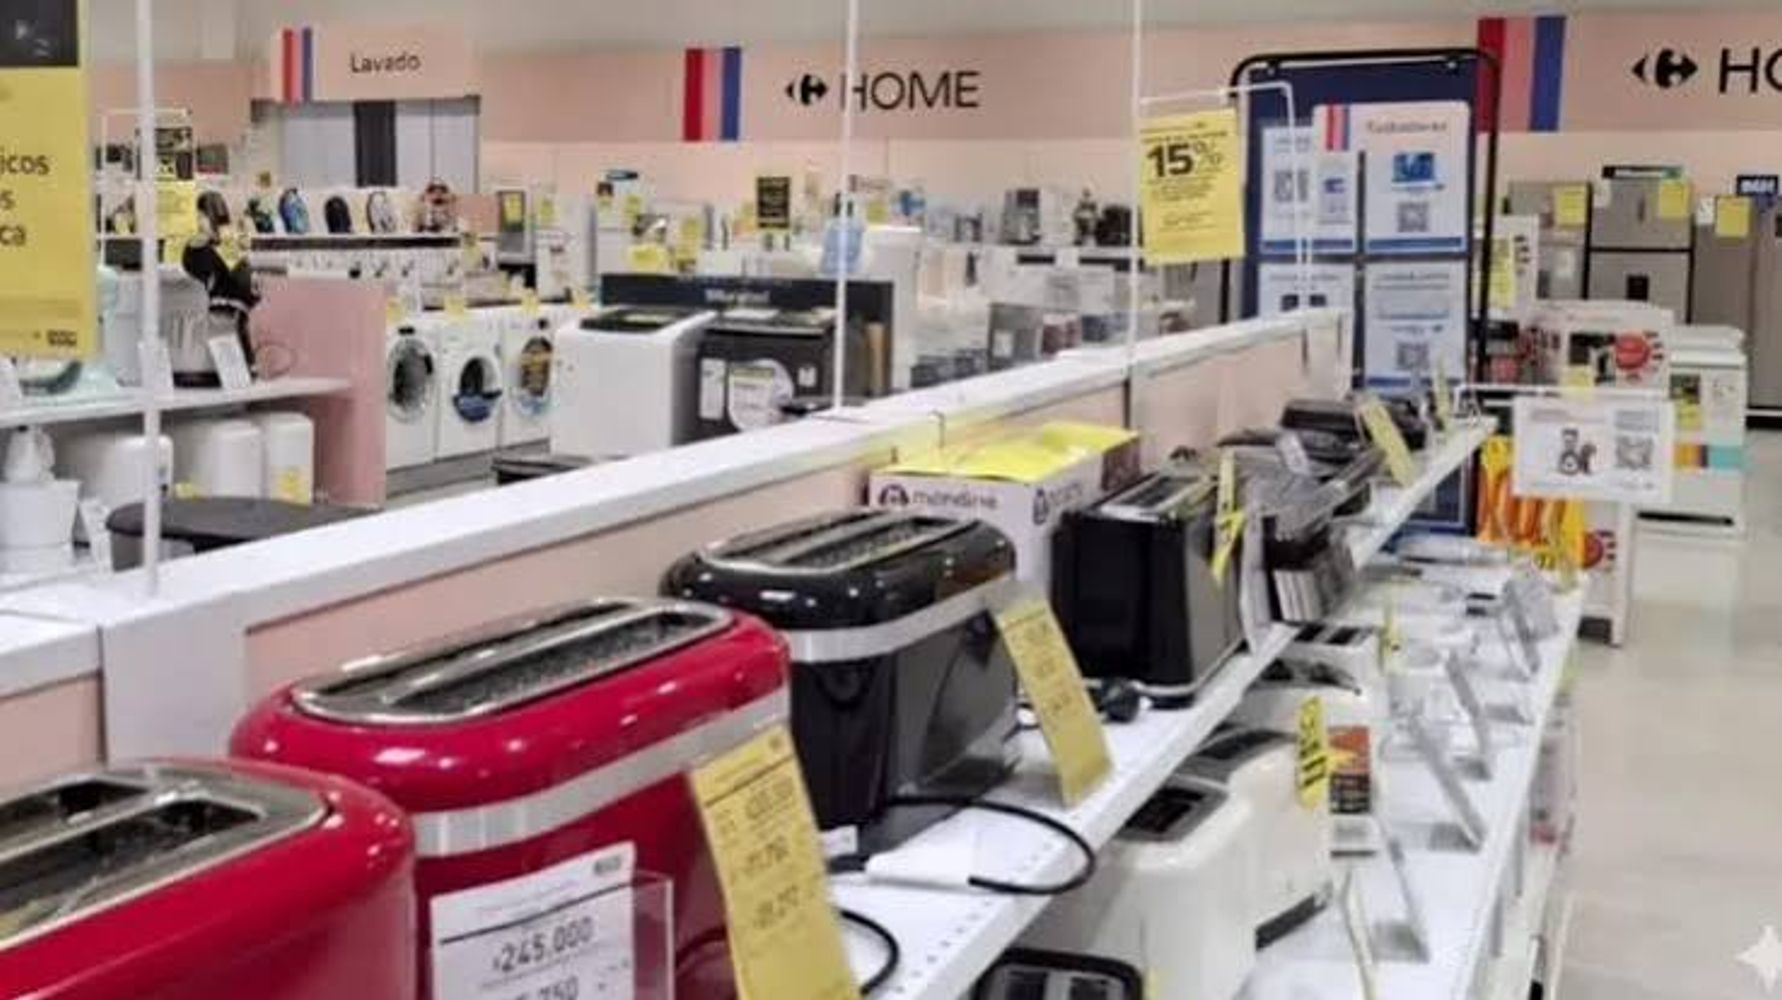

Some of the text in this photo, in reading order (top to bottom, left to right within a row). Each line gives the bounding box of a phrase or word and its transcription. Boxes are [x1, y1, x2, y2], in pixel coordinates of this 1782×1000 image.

[350, 51, 422, 73] Lavado
[841, 71, 981, 110] HOME
[1147, 141, 1224, 178] 15%
